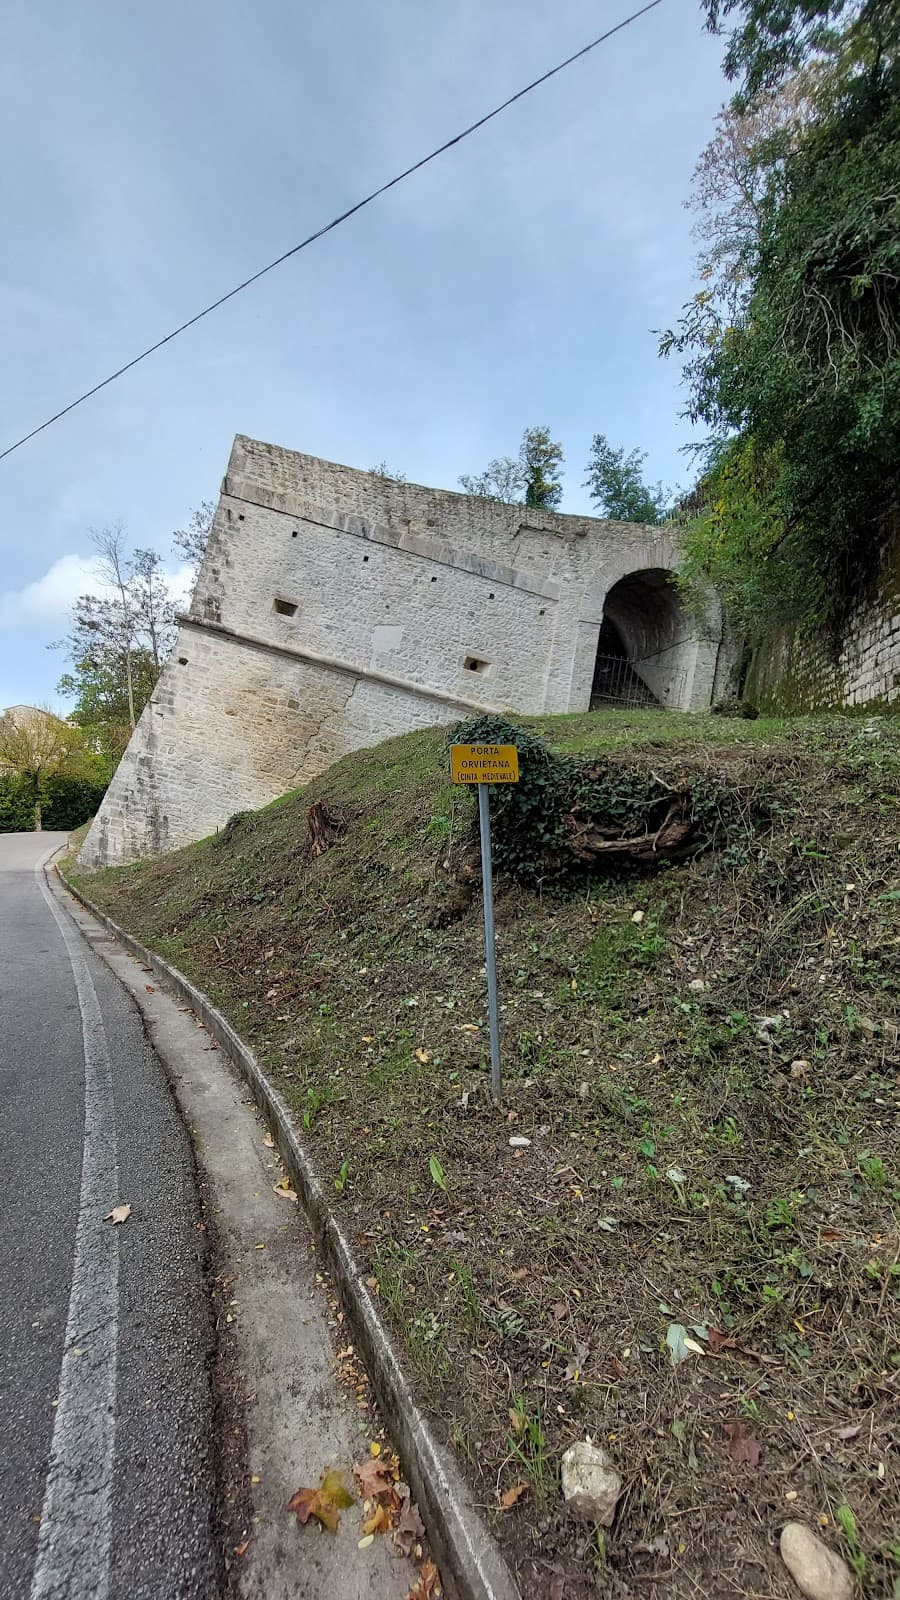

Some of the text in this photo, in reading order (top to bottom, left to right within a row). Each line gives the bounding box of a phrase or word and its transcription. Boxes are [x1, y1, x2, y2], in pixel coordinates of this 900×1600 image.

[470, 747, 499, 755] PORTA
[461, 760, 510, 768] ORVIETANA
[457, 770, 516, 782] (CINTA MEDIEVALE)
